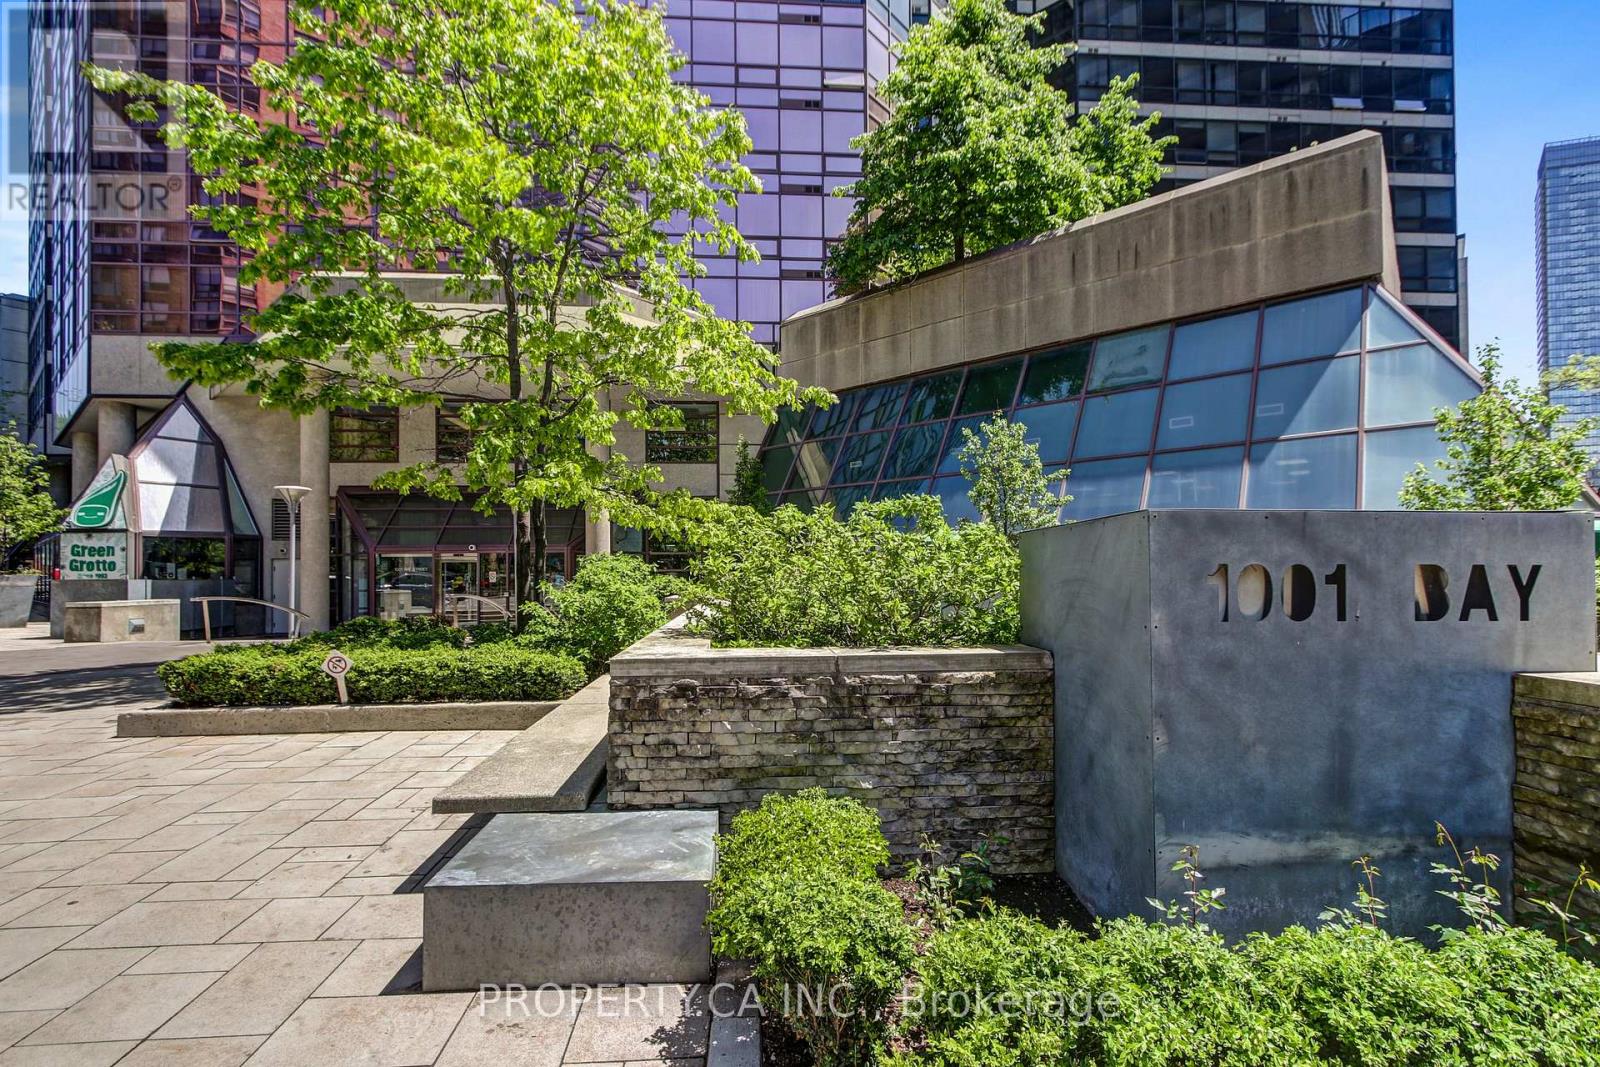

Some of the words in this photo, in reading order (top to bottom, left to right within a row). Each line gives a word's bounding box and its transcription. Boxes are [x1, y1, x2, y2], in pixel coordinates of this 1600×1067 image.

[71, 544, 115, 557] Green
[69, 559, 117, 572] Grotto
[1207, 563, 1347, 623] 1001
[1413, 563, 1542, 622] BAY
